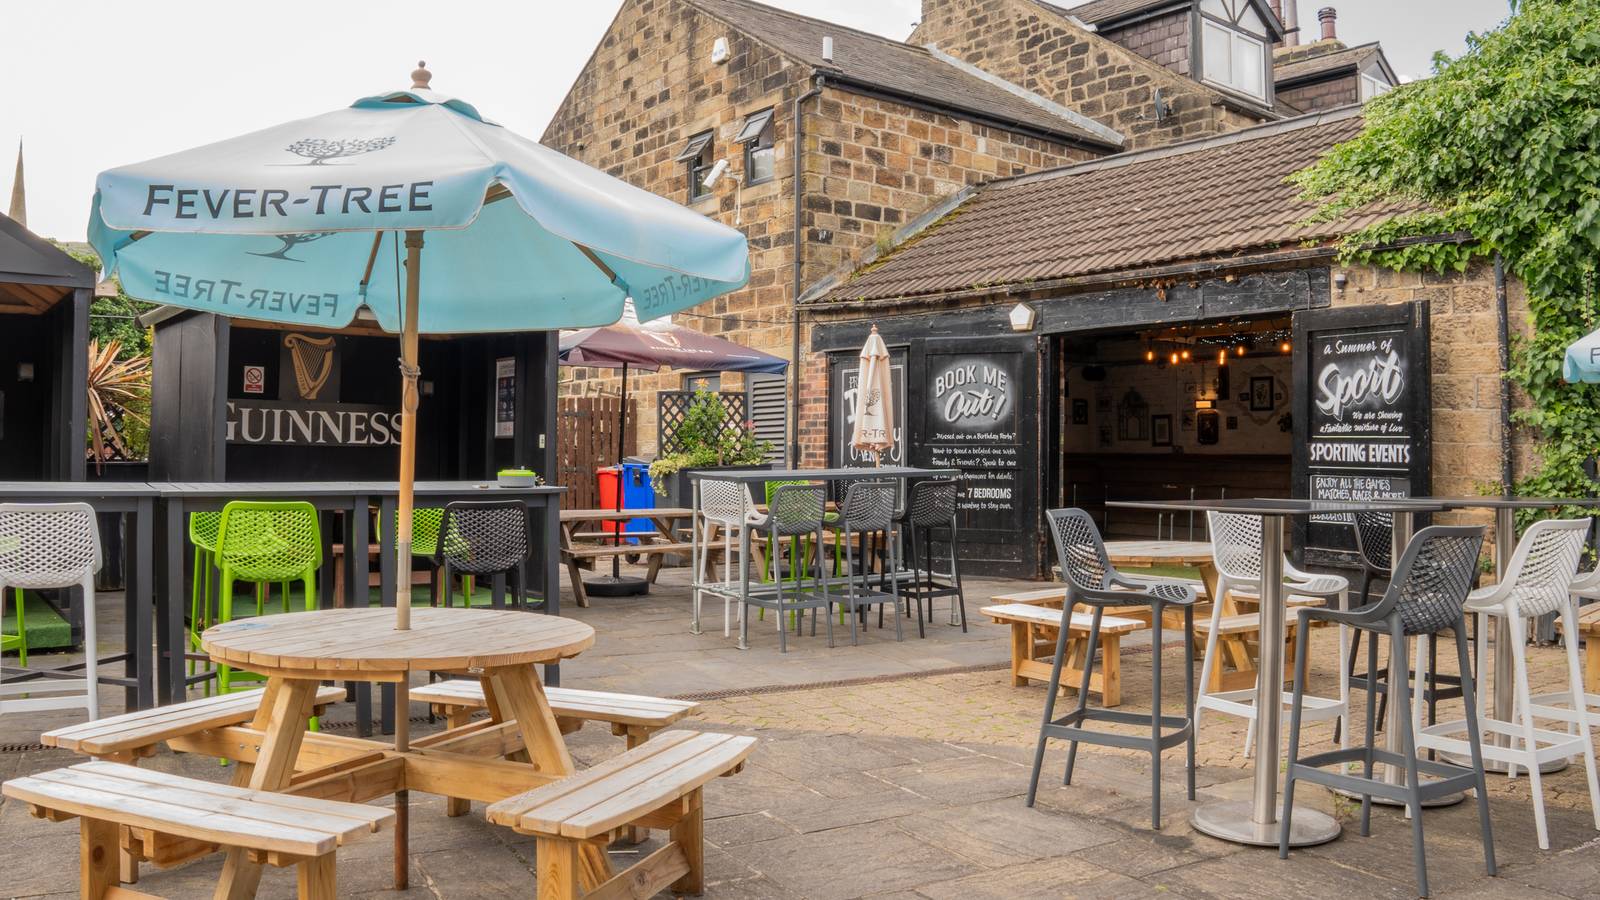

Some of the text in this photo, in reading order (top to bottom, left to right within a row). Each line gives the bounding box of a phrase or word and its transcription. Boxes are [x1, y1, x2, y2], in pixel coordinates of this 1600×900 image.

[142, 180, 434, 219] FEVER-TREE
[1335, 339, 1377, 354] Summer
[1380, 338, 1393, 354] of
[935, 364, 1007, 398] BOOK ME
[1315, 349, 1404, 421] Sport
[944, 387, 1007, 422] Out!
[1377, 410, 1403, 422] Showing
[1310, 443, 1410, 464] SPORTING EVENTS
[968, 488, 974, 498] 7
[974, 488, 1012, 499] BEDROOMS
[1316, 477, 1338, 489] ENJOY
[1340, 478, 1352, 489] ALL
[1354, 478, 1366, 490] THE
